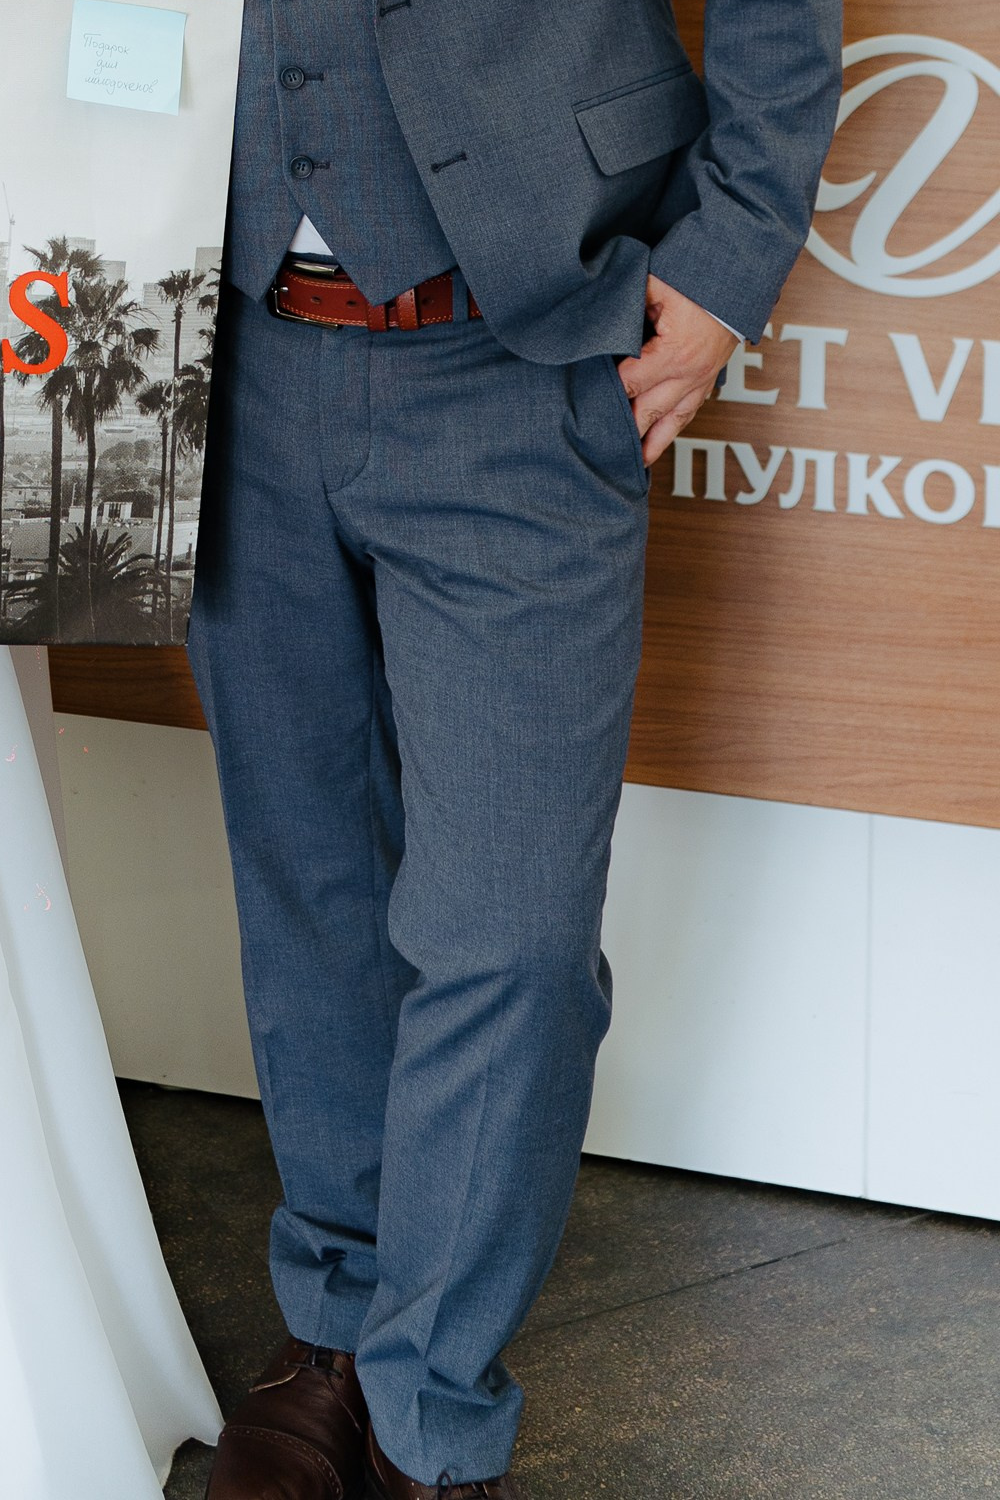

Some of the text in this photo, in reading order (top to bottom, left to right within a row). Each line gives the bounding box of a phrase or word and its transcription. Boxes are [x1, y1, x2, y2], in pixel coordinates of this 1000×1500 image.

[83, 32, 130, 58] Подарок
[93, 59, 118, 75] для
[706, 322, 849, 410] ET
